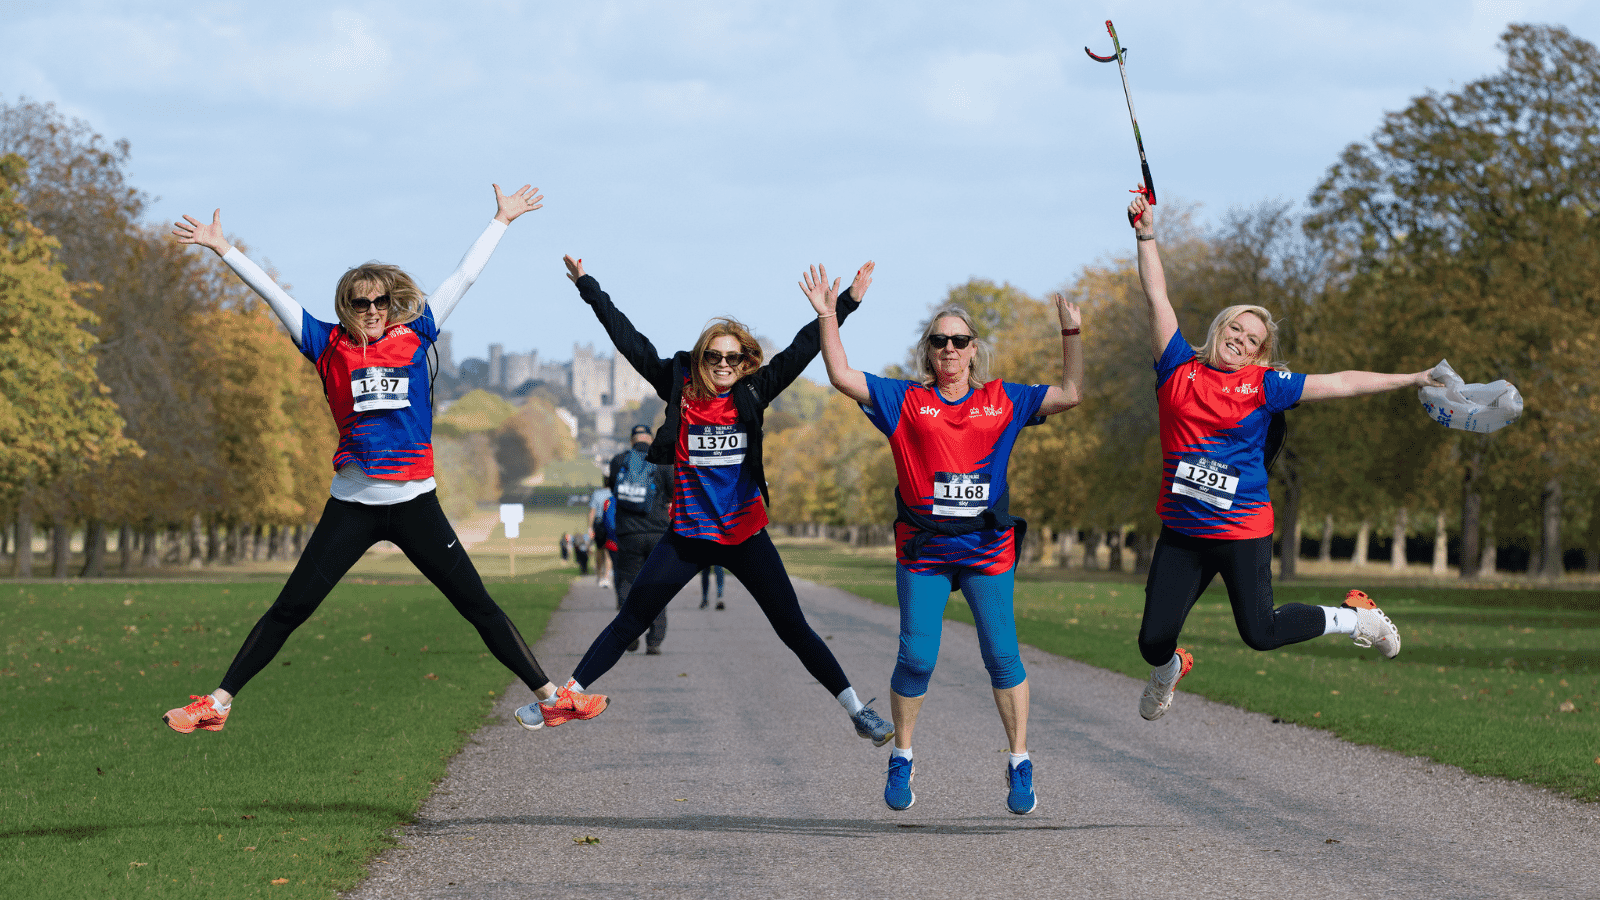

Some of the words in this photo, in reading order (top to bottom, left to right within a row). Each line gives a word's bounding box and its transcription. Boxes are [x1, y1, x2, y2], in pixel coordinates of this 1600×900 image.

[360, 378, 399, 394] 1297
[919, 405, 941, 418] sky
[697, 435, 738, 450] 1370
[1185, 466, 1228, 491] 1291
[943, 485, 984, 500] 1168
